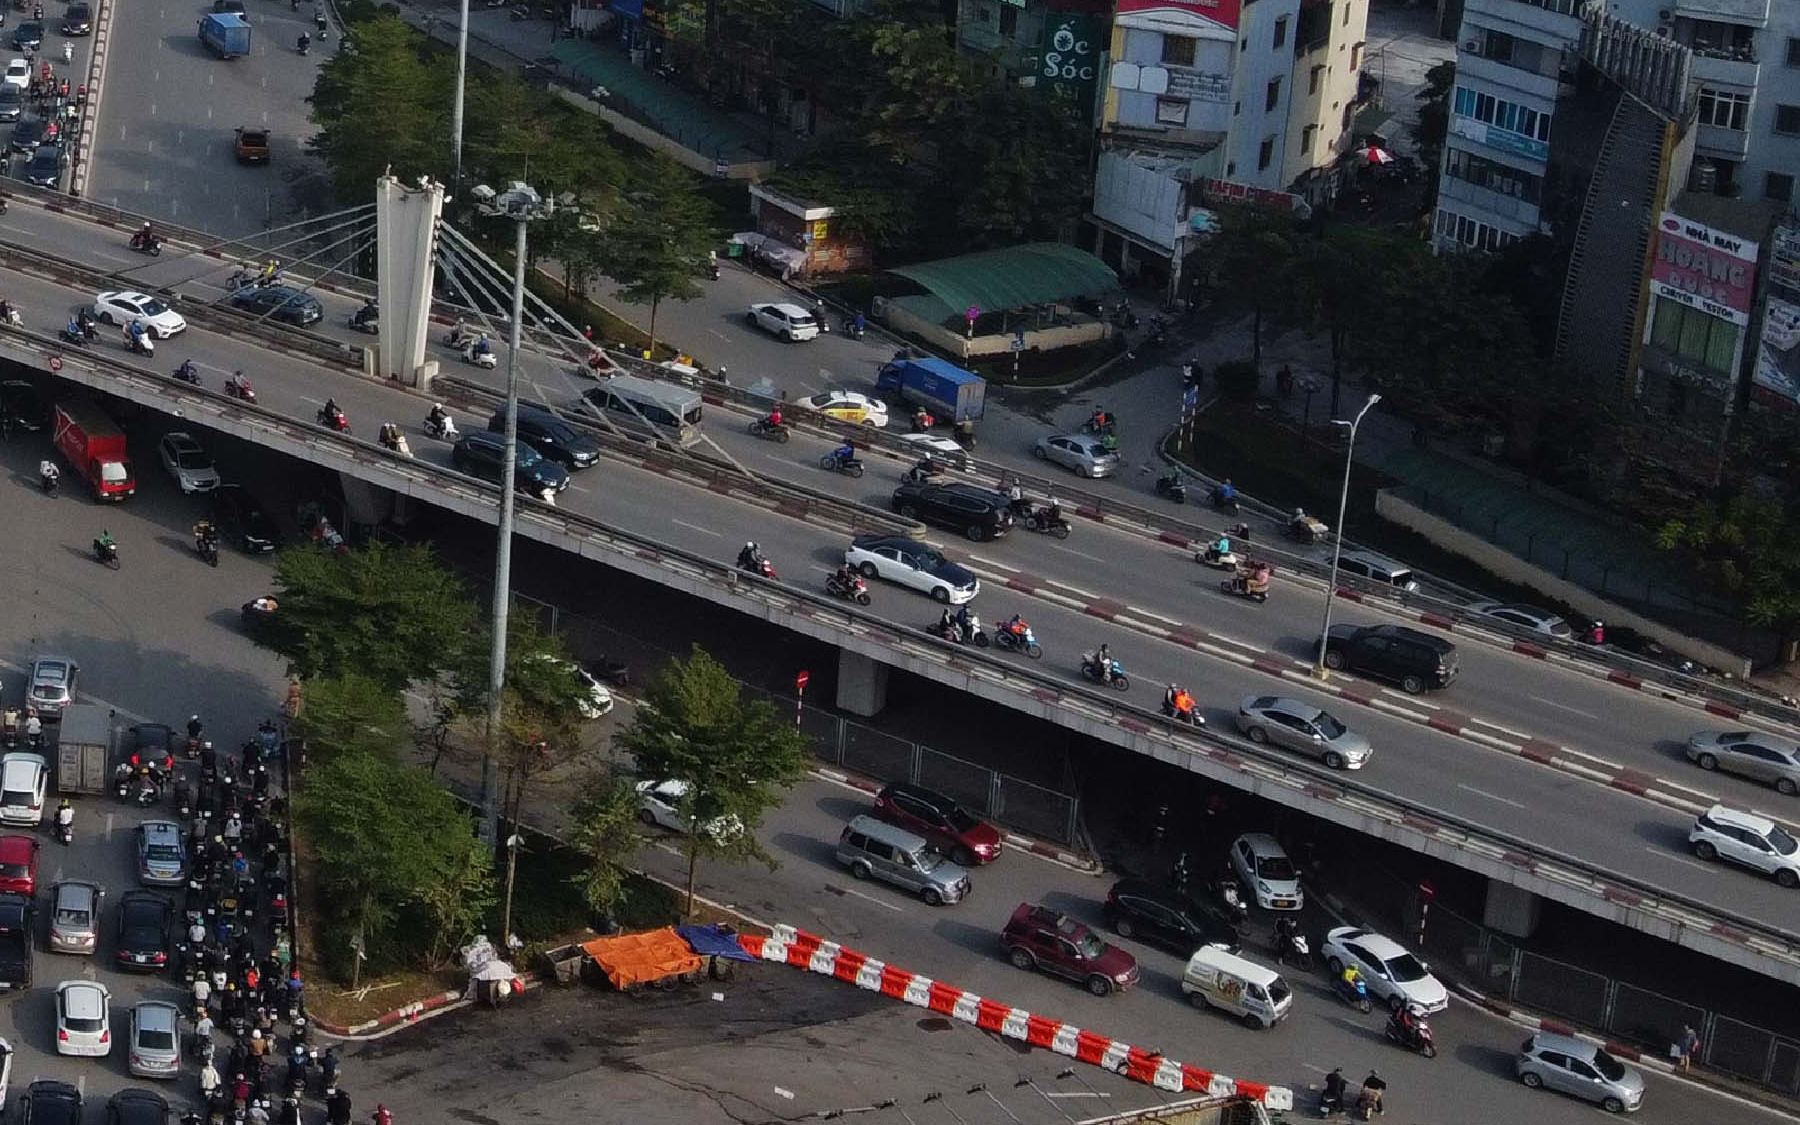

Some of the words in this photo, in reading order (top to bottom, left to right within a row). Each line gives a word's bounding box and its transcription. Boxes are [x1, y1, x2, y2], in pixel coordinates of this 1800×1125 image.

[1053, 20, 1090, 53] Ốc
[1043, 52, 1094, 80] Sóc
[1686, 225, 1711, 244] NHÀ
[1714, 236, 1741, 253] MAY
